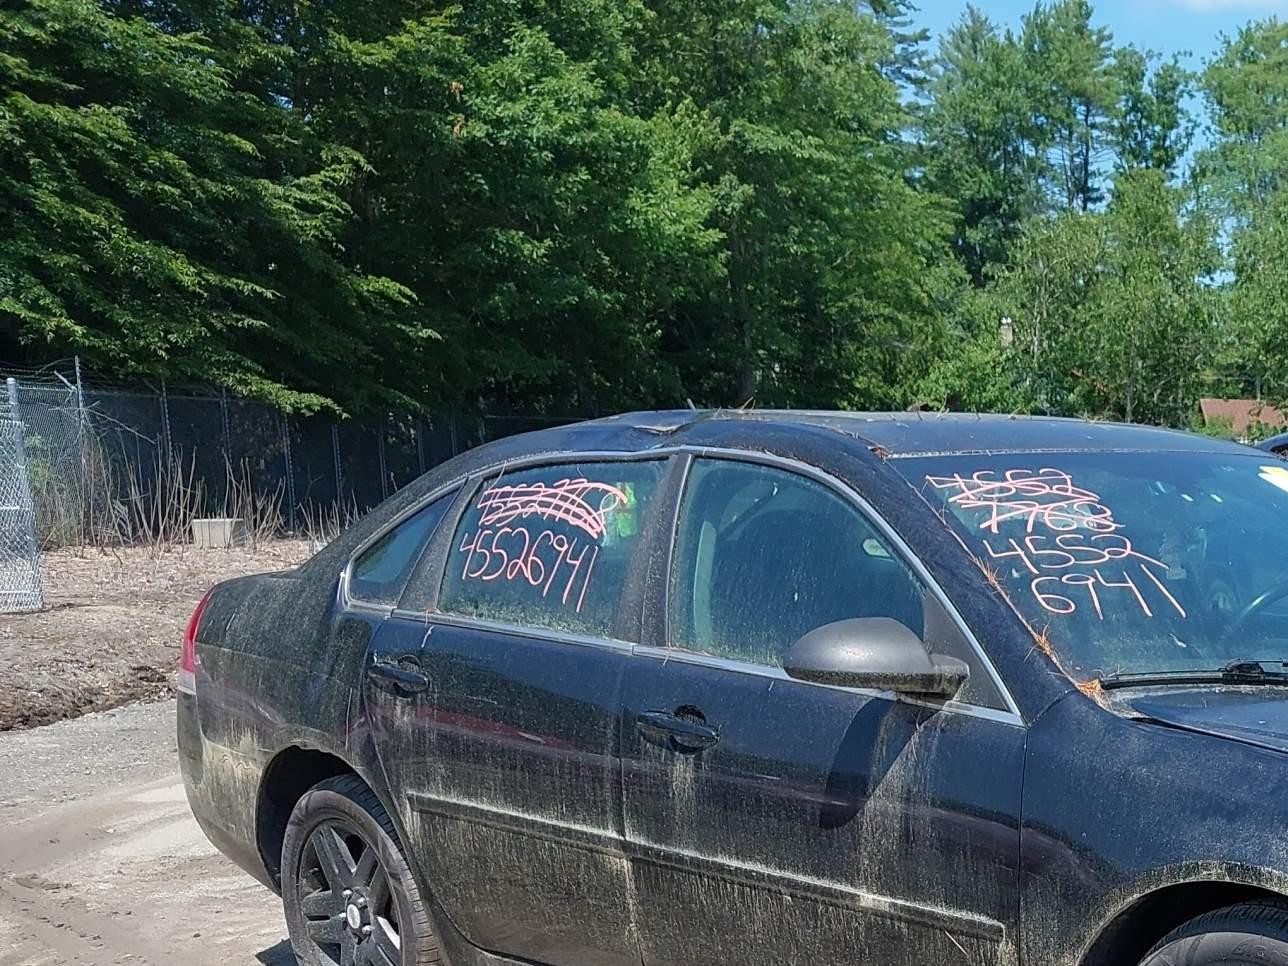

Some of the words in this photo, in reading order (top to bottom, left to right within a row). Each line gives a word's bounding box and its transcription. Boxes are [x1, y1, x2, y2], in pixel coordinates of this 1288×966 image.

[459, 526, 600, 613] 45526941
[982, 533, 1170, 575] 4552
[1030, 563, 1187, 620] 6941
